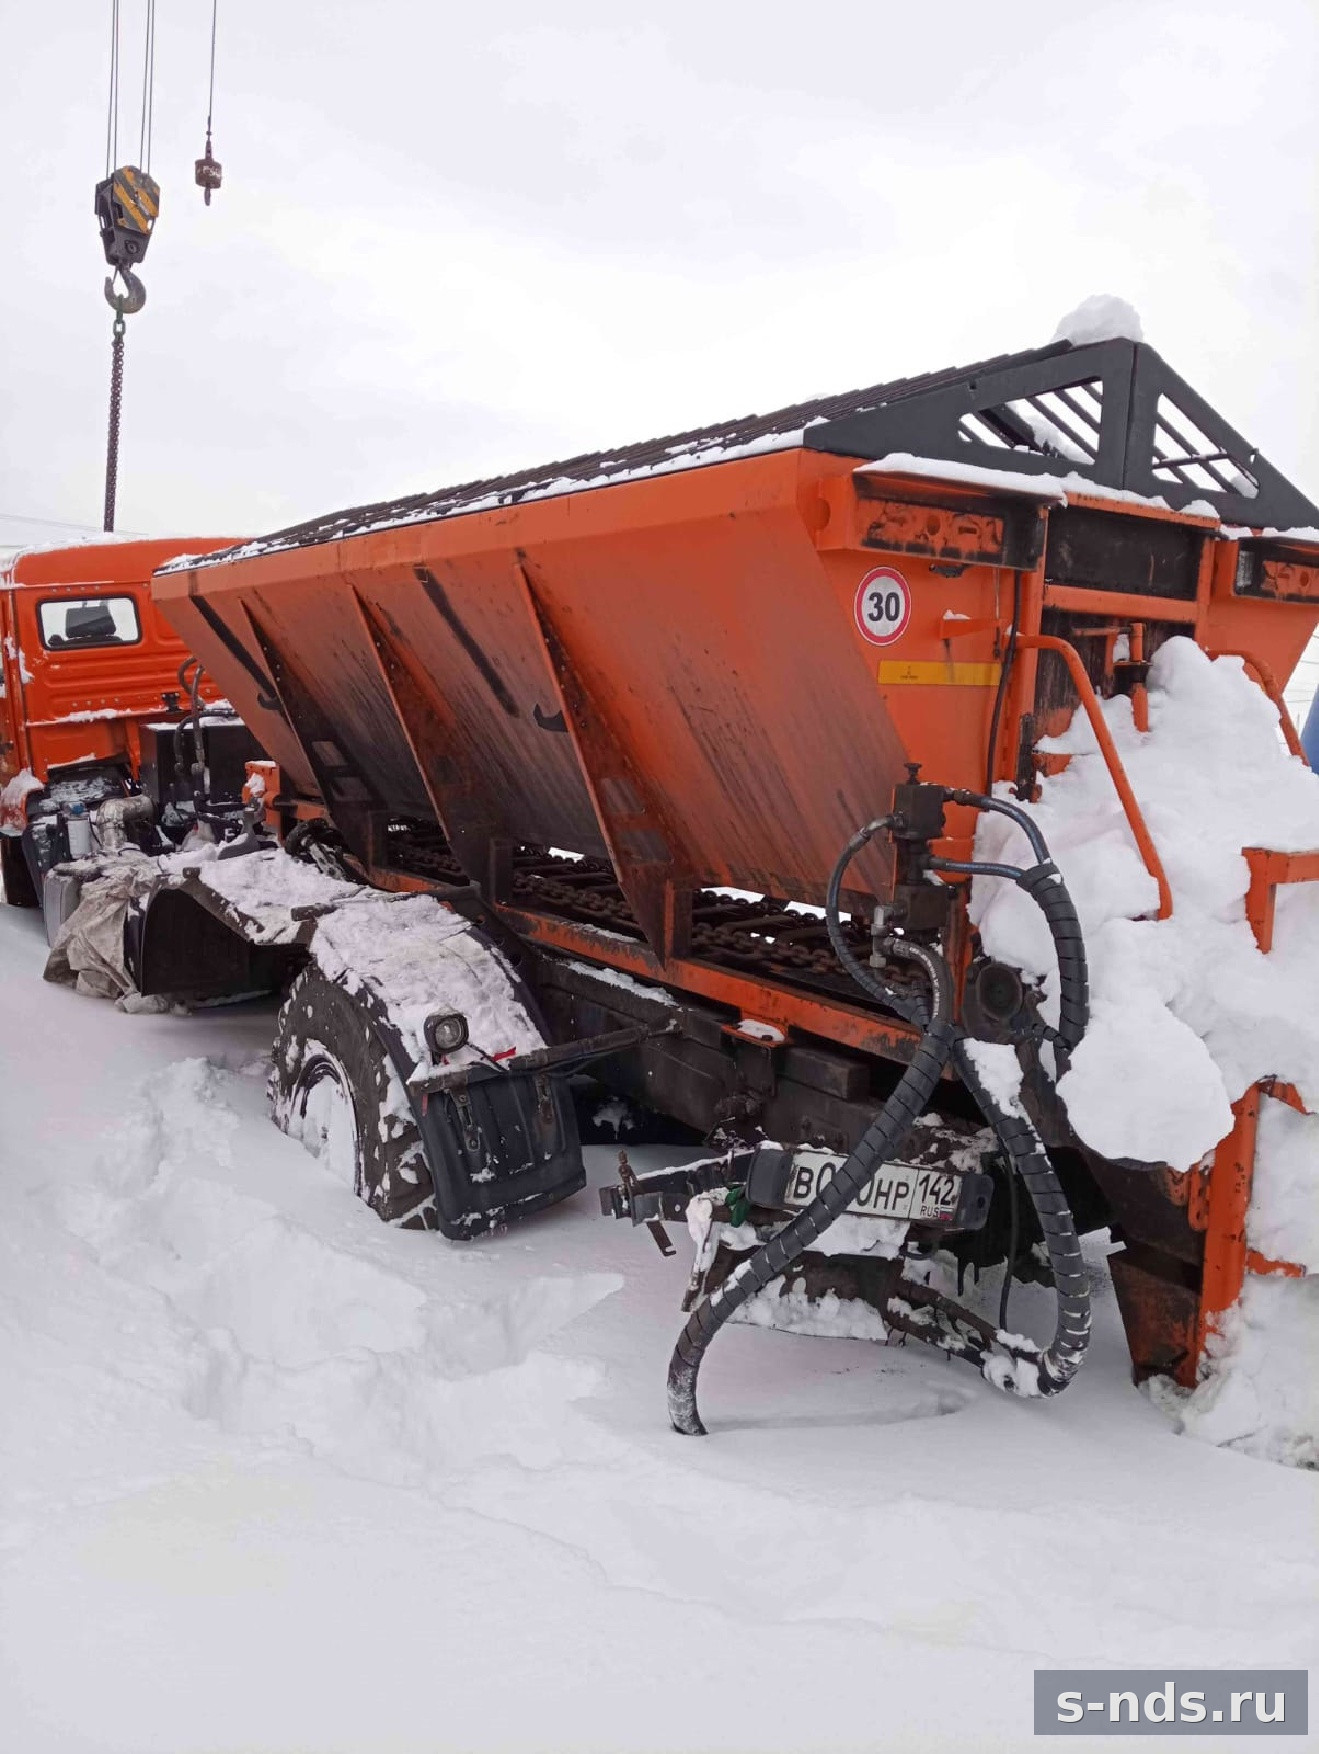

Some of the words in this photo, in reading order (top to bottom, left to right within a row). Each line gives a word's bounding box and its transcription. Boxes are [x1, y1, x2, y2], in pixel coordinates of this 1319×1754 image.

[868, 592, 900, 622] 30
[919, 1173, 955, 1206] 142
[920, 1205, 939, 1219] RUS
